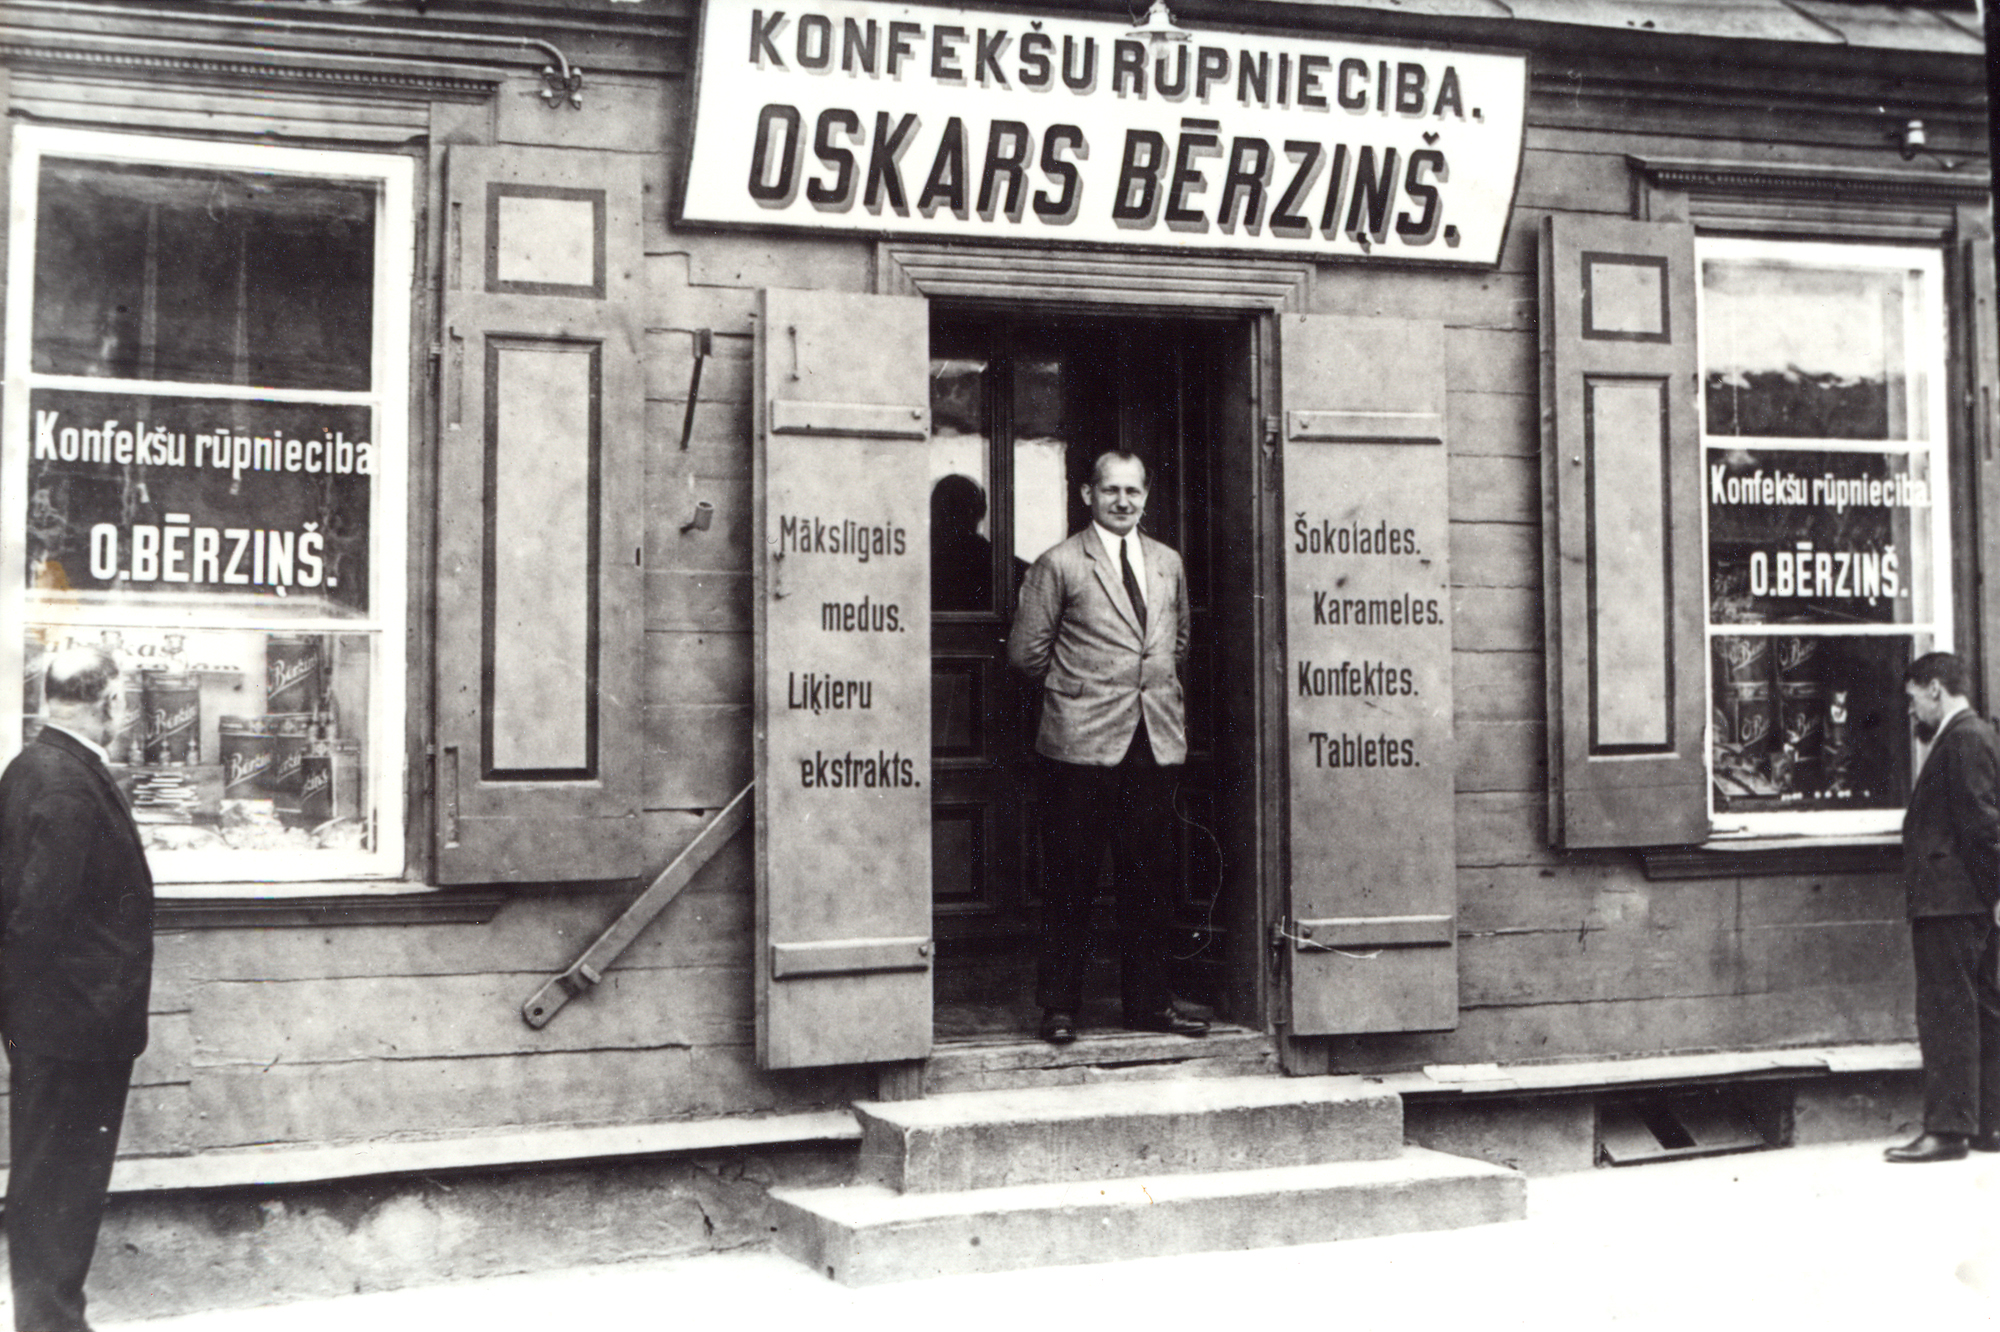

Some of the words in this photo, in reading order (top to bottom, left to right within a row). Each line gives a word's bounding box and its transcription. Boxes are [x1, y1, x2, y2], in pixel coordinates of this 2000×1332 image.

[749, 9, 1098, 95] KONFEKŠU
[748, 103, 1089, 225] OSKARS
[1112, 117, 1461, 253] BĒRZIŅŠ.
[35, 410, 186, 467] Konfekšu
[1711, 464, 1808, 506] Konfekšu
[780, 515, 906, 563] Mākslīgais
[1295, 512, 1421, 555] Šokolades.
[822, 595, 905, 632] medus.
[1314, 591, 1444, 625] Karameles.
[788, 671, 872, 716] Liķieru
[1298, 661, 1419, 696] Konfektes.
[801, 750, 921, 789] ekstrakts.
[1309, 732, 1421, 768] Tabletes.
